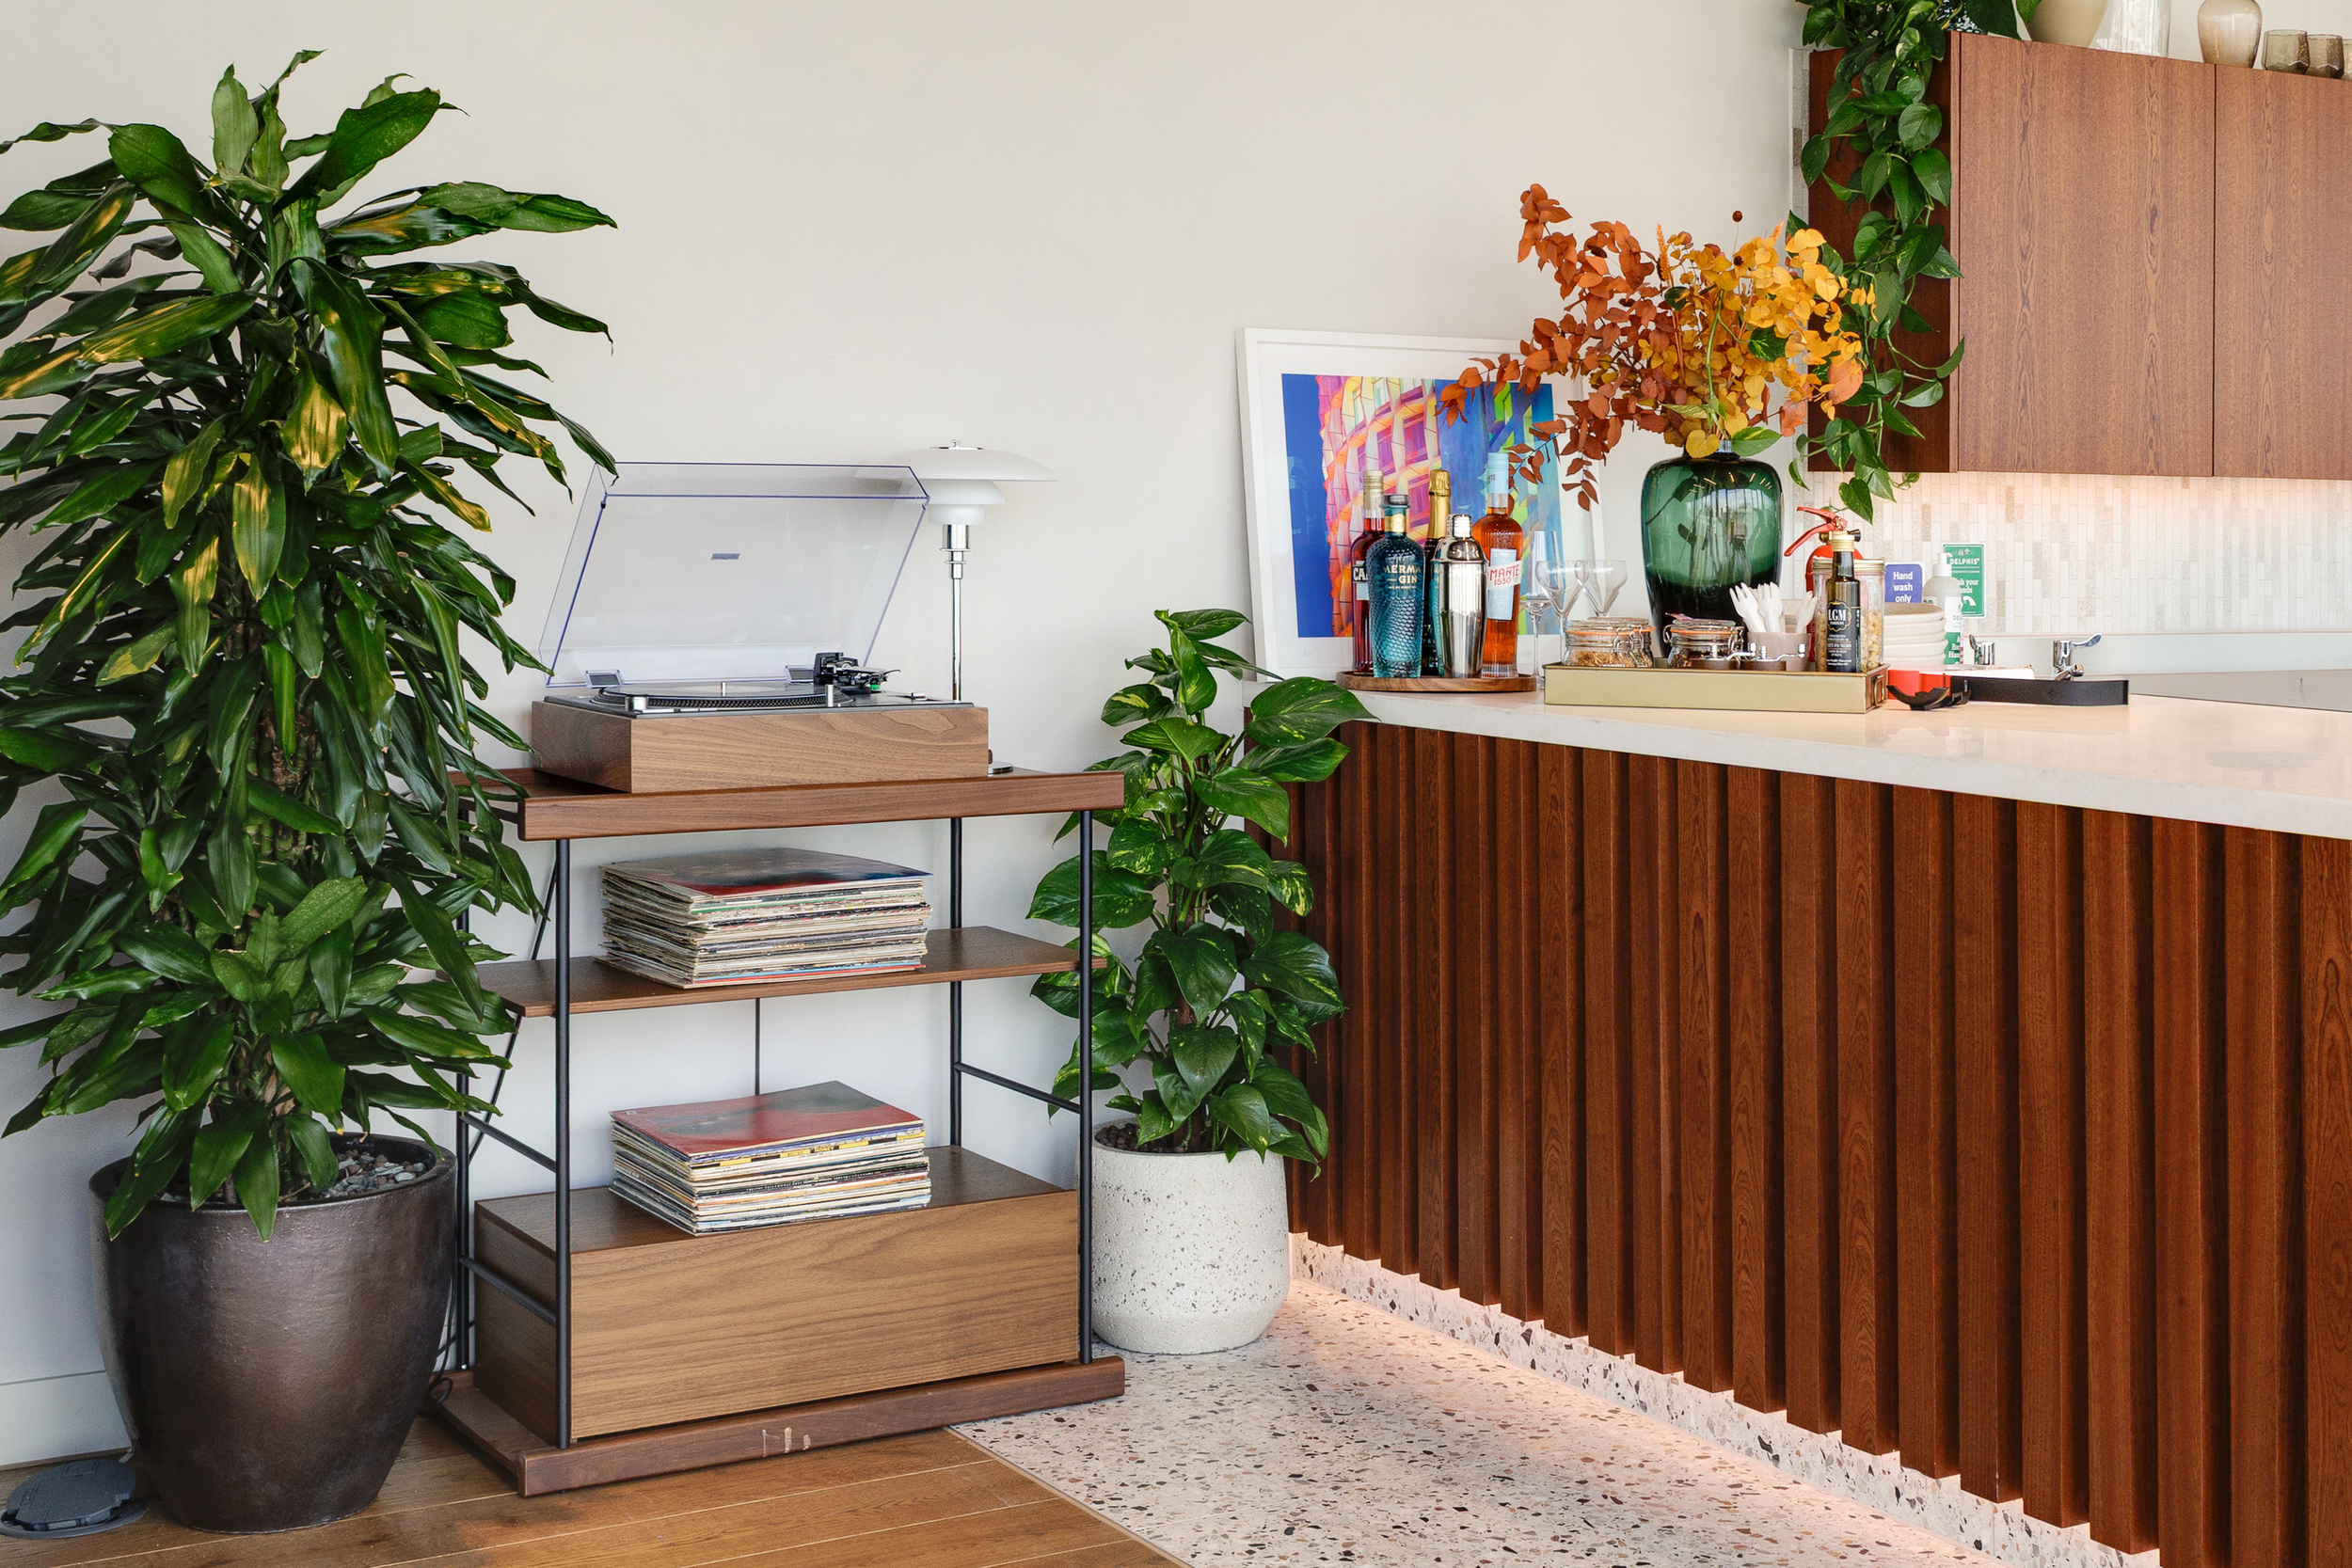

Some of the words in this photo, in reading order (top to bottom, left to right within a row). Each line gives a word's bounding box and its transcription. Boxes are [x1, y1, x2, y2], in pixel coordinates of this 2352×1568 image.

[1487, 564, 1519, 581] MANTE
[1893, 571, 1913, 580] Hand
[1398, 575, 1418, 583] GIN
[1893, 583, 1914, 592] wash
[1895, 594, 1912, 603] only
[1828, 609, 1847, 621] LGM
